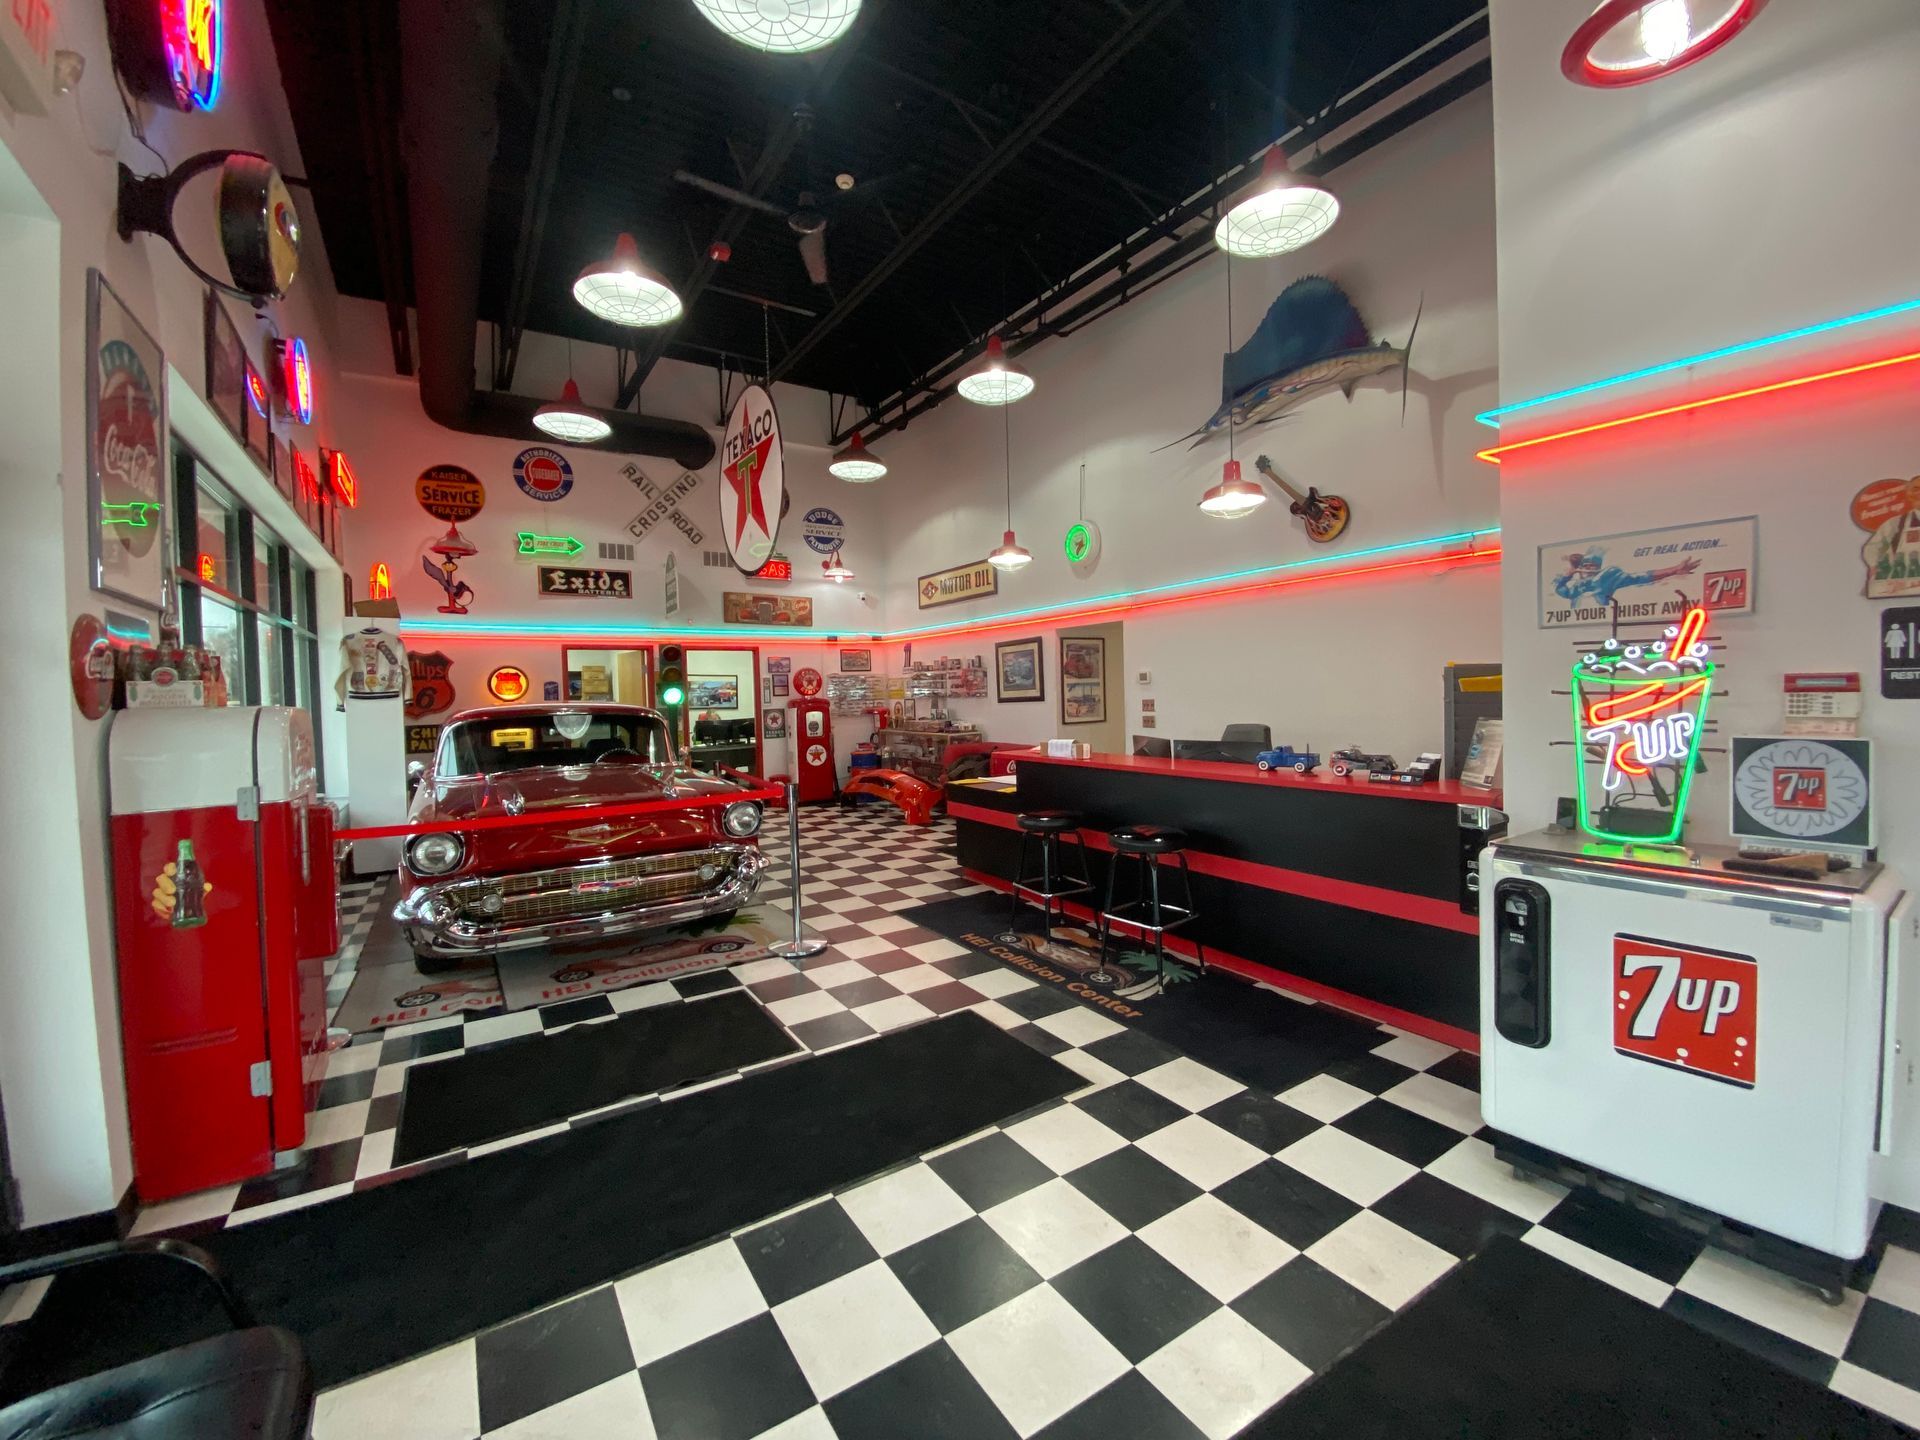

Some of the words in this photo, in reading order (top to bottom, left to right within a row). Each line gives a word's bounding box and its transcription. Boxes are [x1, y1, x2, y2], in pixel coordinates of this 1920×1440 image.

[726, 408, 773, 464] TEXACO
[431, 471, 468, 481] KAISER
[421, 485, 480, 505] SERVICE
[522, 484, 567, 500] SERVICE
[431, 505, 472, 516] FRAZER
[622, 466, 655, 500] RAIL
[668, 511, 704, 545] ROAD
[629, 474, 697, 538] CROSSING
[808, 511, 839, 525] DODGE
[1633, 546, 1652, 558] GET
[1653, 543, 1680, 556] REAL
[546, 569, 625, 591] Exide
[939, 573, 972, 596] MOTOR
[974, 568, 992, 588] OIL
[577, 589, 627, 597] BATTERIES
[1574, 606, 1607, 621] YOUR
[1610, 602, 1659, 619] THIRST
[1778, 772, 1820, 801] 7up
[541, 981, 593, 999] HEI
[601, 957, 719, 986] Collision
[959, 932, 990, 948] HEI
[992, 944, 1067, 984] Collision
[1066, 982, 1144, 1019] Center
[1620, 954, 1741, 1040] 7up
